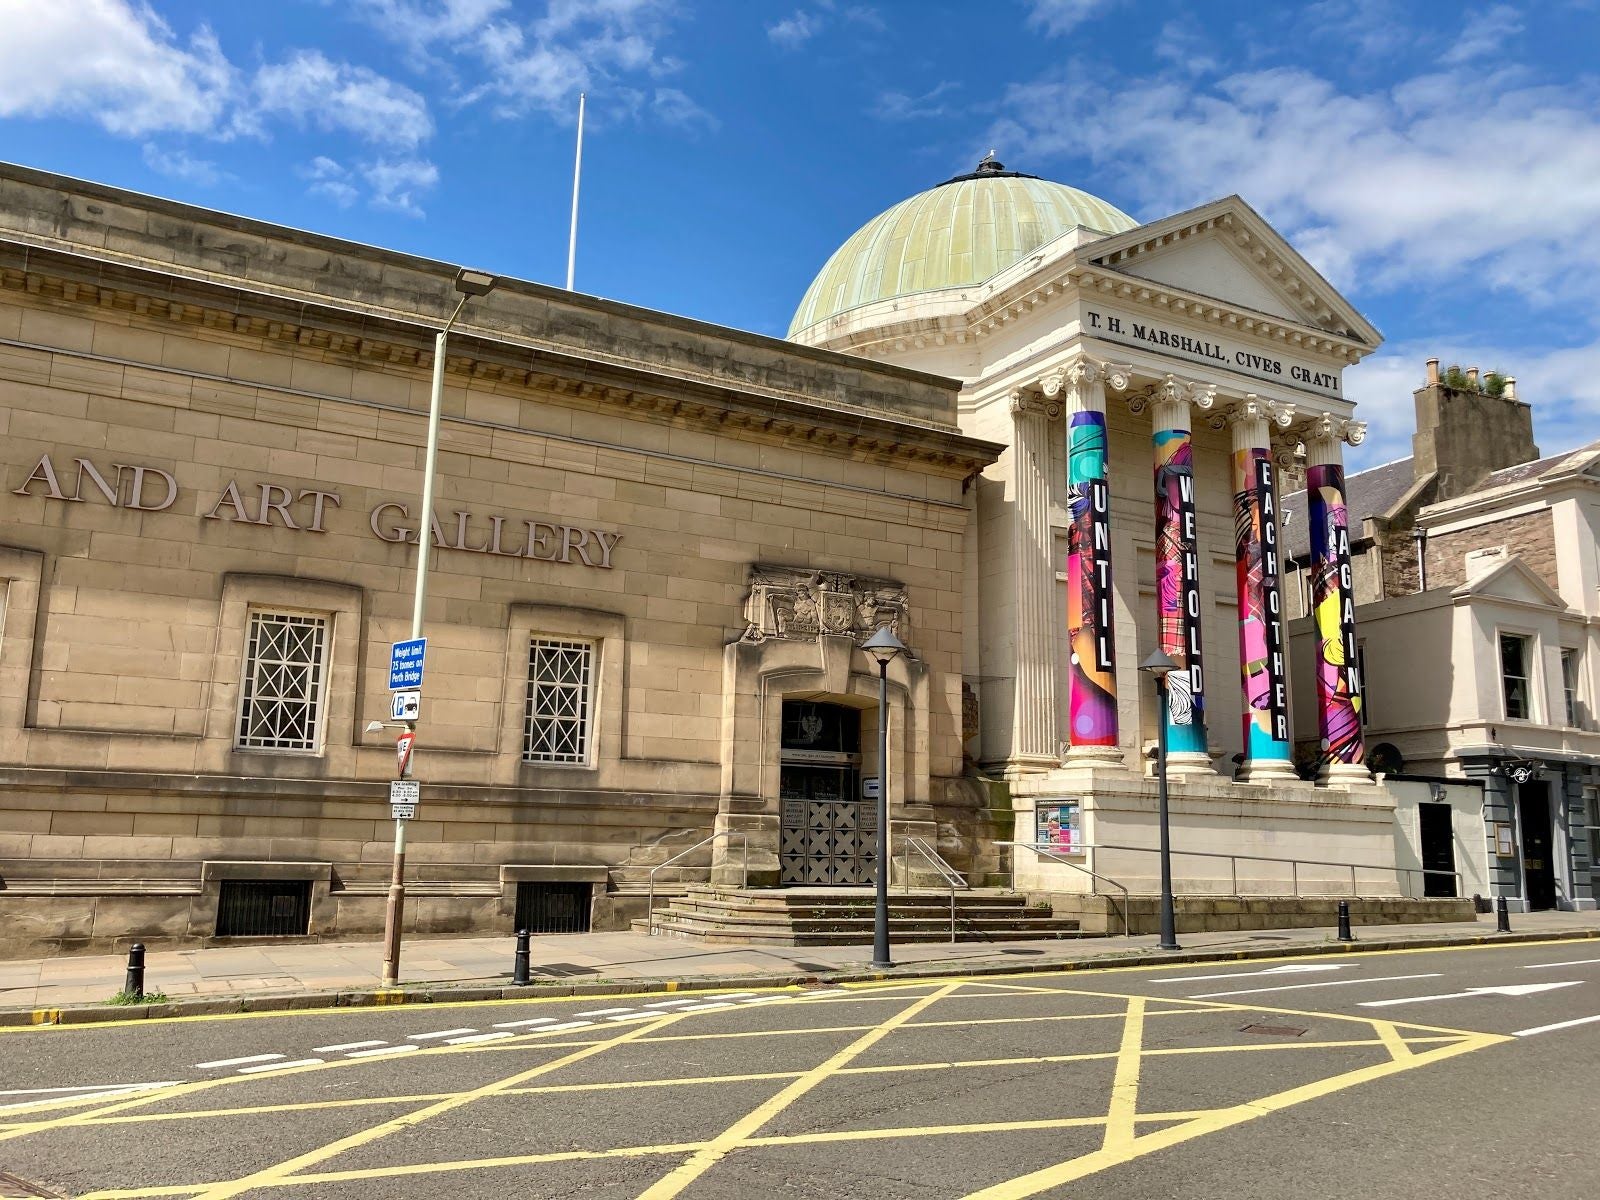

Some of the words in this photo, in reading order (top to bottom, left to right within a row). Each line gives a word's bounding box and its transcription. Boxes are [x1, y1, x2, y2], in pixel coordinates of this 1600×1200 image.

[1088, 312, 1102, 328] T.
[1107, 316, 1126, 335] H.
[1132, 323, 1231, 364] MARSHALL,
[1235, 351, 1282, 374] CIVES
[1291, 365, 1338, 390] GRATI
[12, 453, 178, 511] AND
[205, 480, 341, 533] ART
[370, 502, 624, 569] GALLERY
[1094, 484, 1112, 667] UNTIL
[1186, 552, 1203, 693] HOLD
[1262, 462, 1277, 575] EACH
[1270, 590, 1287, 739] OTHER
[1339, 529, 1360, 694] AGAIN
[391, 672, 404, 683] Perth
[404, 670, 420, 683] Bridge
[394, 646, 411, 659] Weight
[411, 644, 423, 656] limit
[399, 660, 415, 670] tonnes
[415, 659, 423, 668] on
